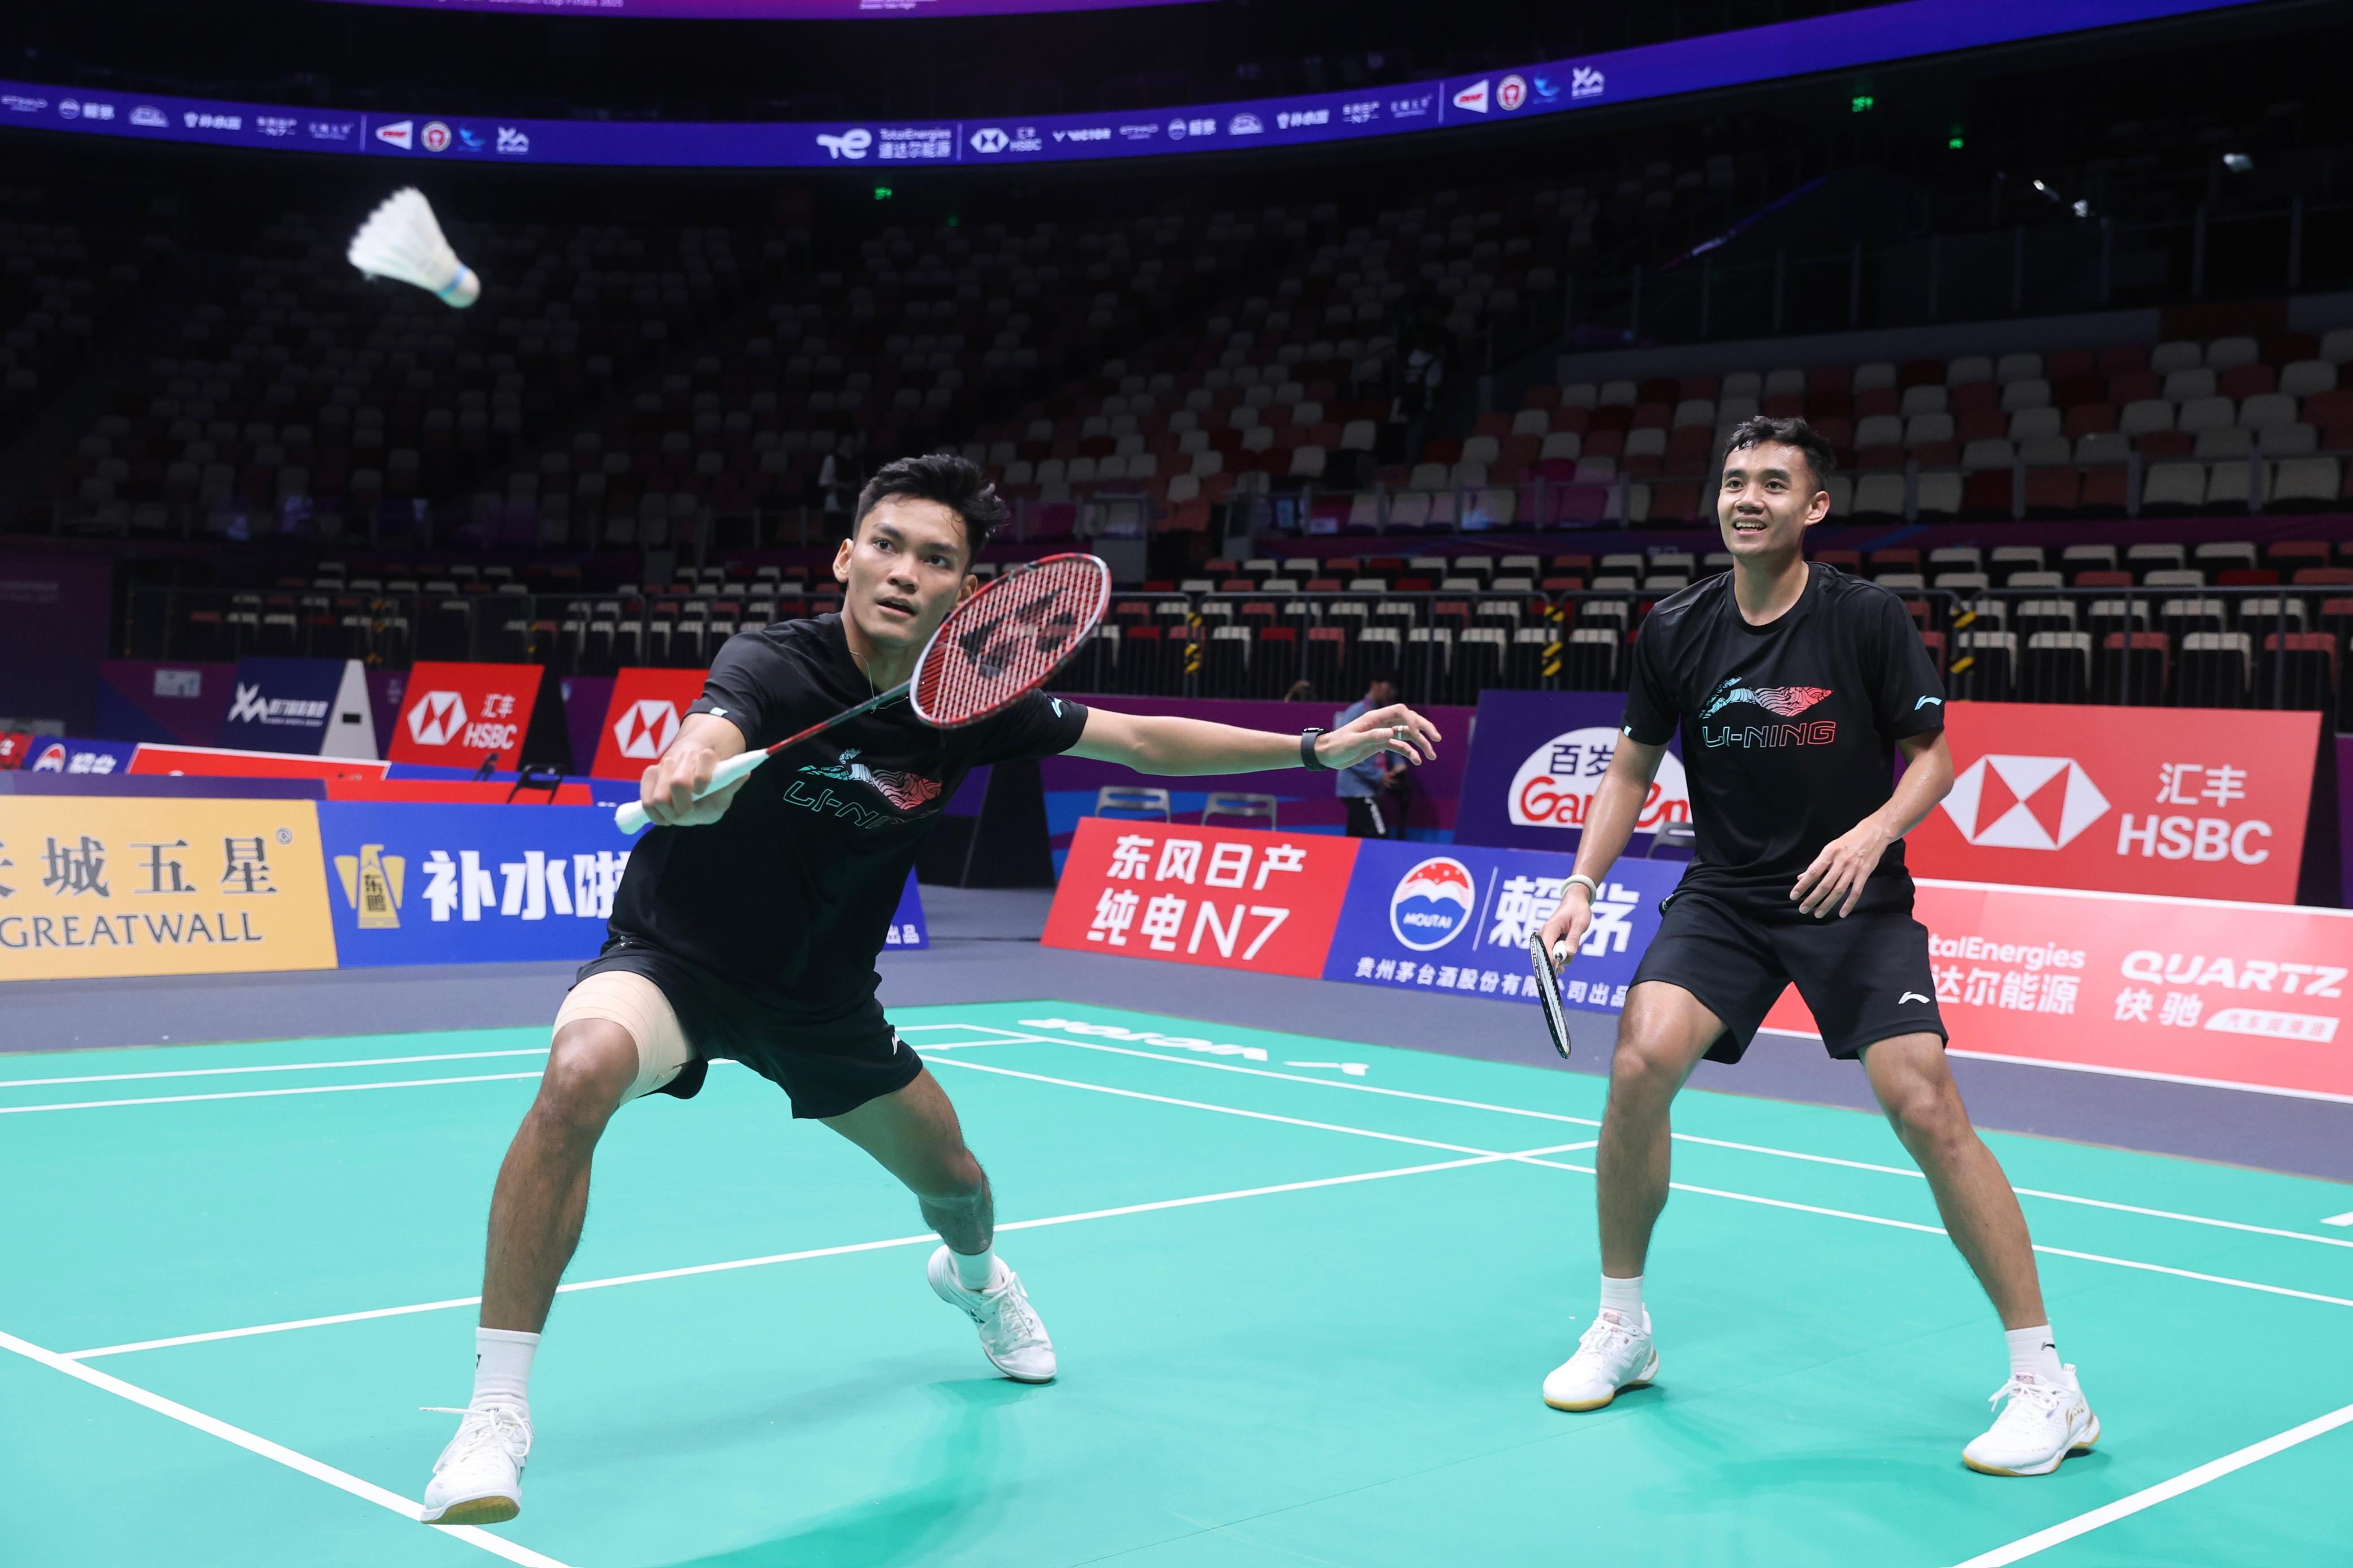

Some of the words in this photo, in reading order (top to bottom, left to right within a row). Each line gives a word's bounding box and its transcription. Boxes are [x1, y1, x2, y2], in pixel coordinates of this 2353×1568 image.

[481, 693, 516, 718] 汇丰
[463, 722, 518, 750] HSBC
[1702, 720, 1837, 748] LI-NING
[2155, 762, 2247, 807] 汇丰
[2117, 813, 2273, 865] HSBC
[0, 836, 277, 899] 城五星
[1106, 834, 1307, 890] 东风日产
[0, 912, 264, 949] GREATWALL
[1403, 912, 1453, 929] MOUTAI
[1928, 934, 2087, 970] talEnergies
[2121, 950, 2348, 998] QUARTZ
[1355, 956, 1630, 1008] 贵州茅台酒股份有限司出品
[1931, 964, 2082, 1015] 达尔能源
